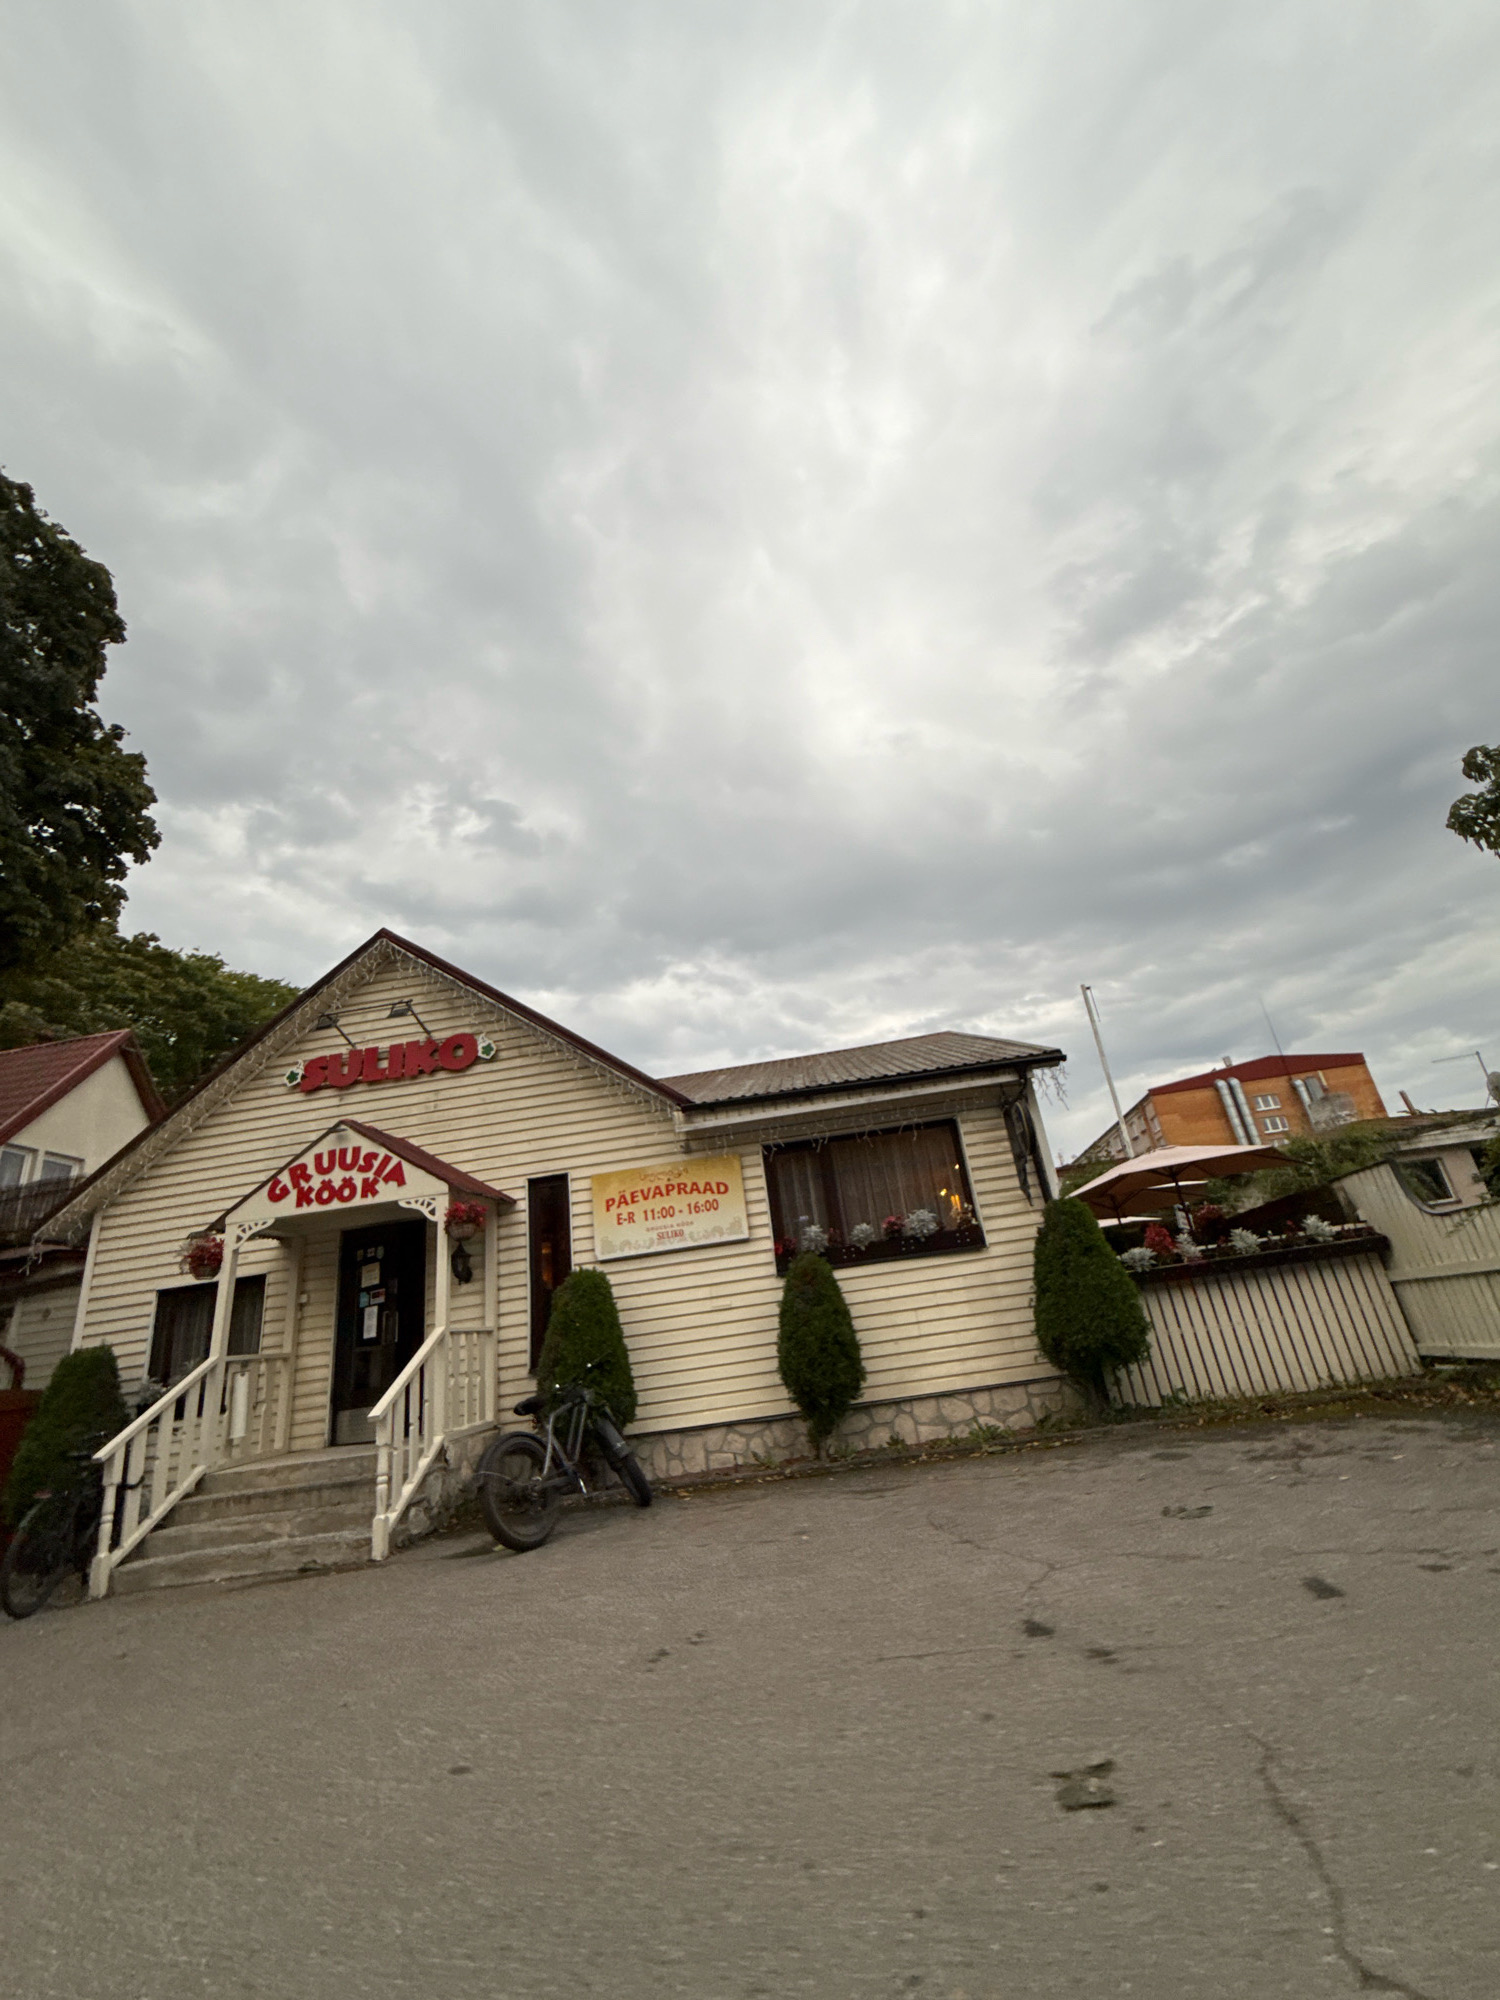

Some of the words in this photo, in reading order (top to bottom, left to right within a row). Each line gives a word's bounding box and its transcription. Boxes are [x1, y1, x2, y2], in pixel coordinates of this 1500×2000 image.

[299, 1032, 479, 1093] SULIKO
[267, 1146, 407, 1203] GRUUSIA
[296, 1176, 380, 1209] KÖÖK
[605, 1181, 729, 1213] PÄEVAPRAAD
[616, 1211, 636, 1226] E-R
[643, 1205, 675, 1222] 11:00
[687, 1198, 719, 1215] 16:00
[656, 1229, 684, 1241] SULIKO
